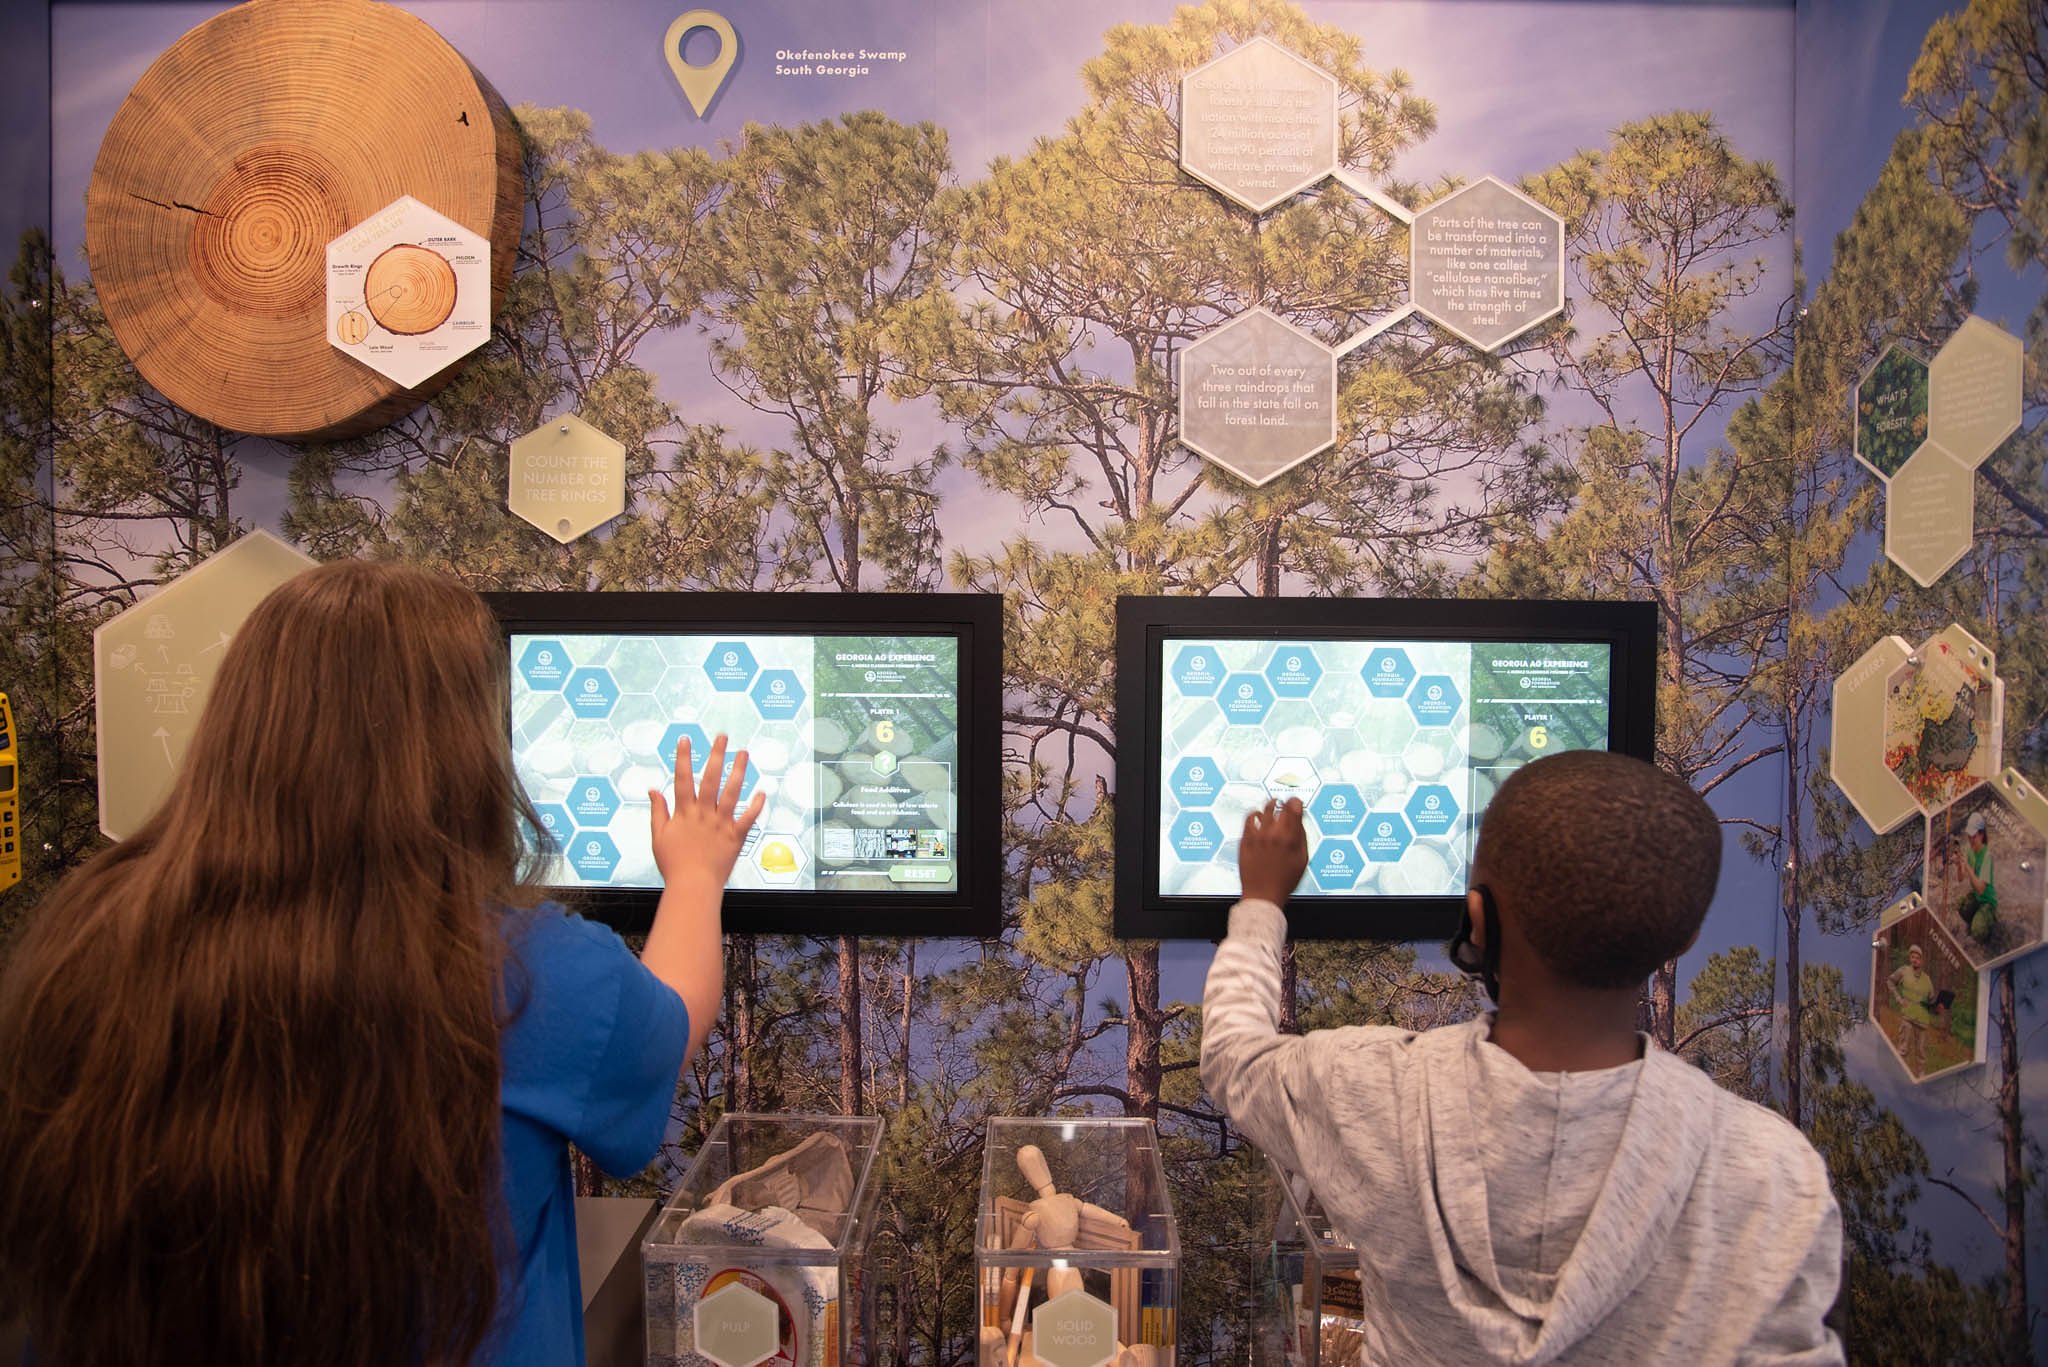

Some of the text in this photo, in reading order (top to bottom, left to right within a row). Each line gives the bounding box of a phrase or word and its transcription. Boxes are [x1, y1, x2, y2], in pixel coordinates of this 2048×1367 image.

[776, 50, 907, 62] Okefenokee Swamp
[776, 65, 869, 77] South Georgia
[1229, 128, 1264, 139] million
[1208, 159, 1239, 171] which
[1264, 161, 1312, 175] privately
[1238, 178, 1279, 188] owned.
[1432, 217, 1542, 230] Parts of the tree can
[1428, 229, 1546, 244] be transformed into a
[1430, 244, 1544, 259] number of materials,
[1447, 257, 1527, 271] like one called
[1432, 285, 1542, 299] which has five times
[1447, 299, 1526, 314] the strength of
[1472, 314, 1500, 325] steel.
[1211, 364, 1306, 379] Two out of every
[1202, 380, 1314, 395] three raindrops that
[1198, 396, 1318, 409] fall in the state fall on
[1876, 388, 1908, 405] WHAT IS
[1888, 407, 1894, 416] A
[1225, 413, 1288, 425] forest land.
[526, 456, 608, 469] COUNT THE
[523, 471, 608, 485] NUMBER OF
[527, 488, 607, 502] TREE RINGS
[876, 720, 894, 743] 6
[1529, 726, 1548, 749] 6
[904, 869, 936, 878] RESET
[722, 1321, 750, 1332] PULP
[1056, 1319, 1093, 1332] SOLID
[1052, 1335, 1097, 1345] WOOD
